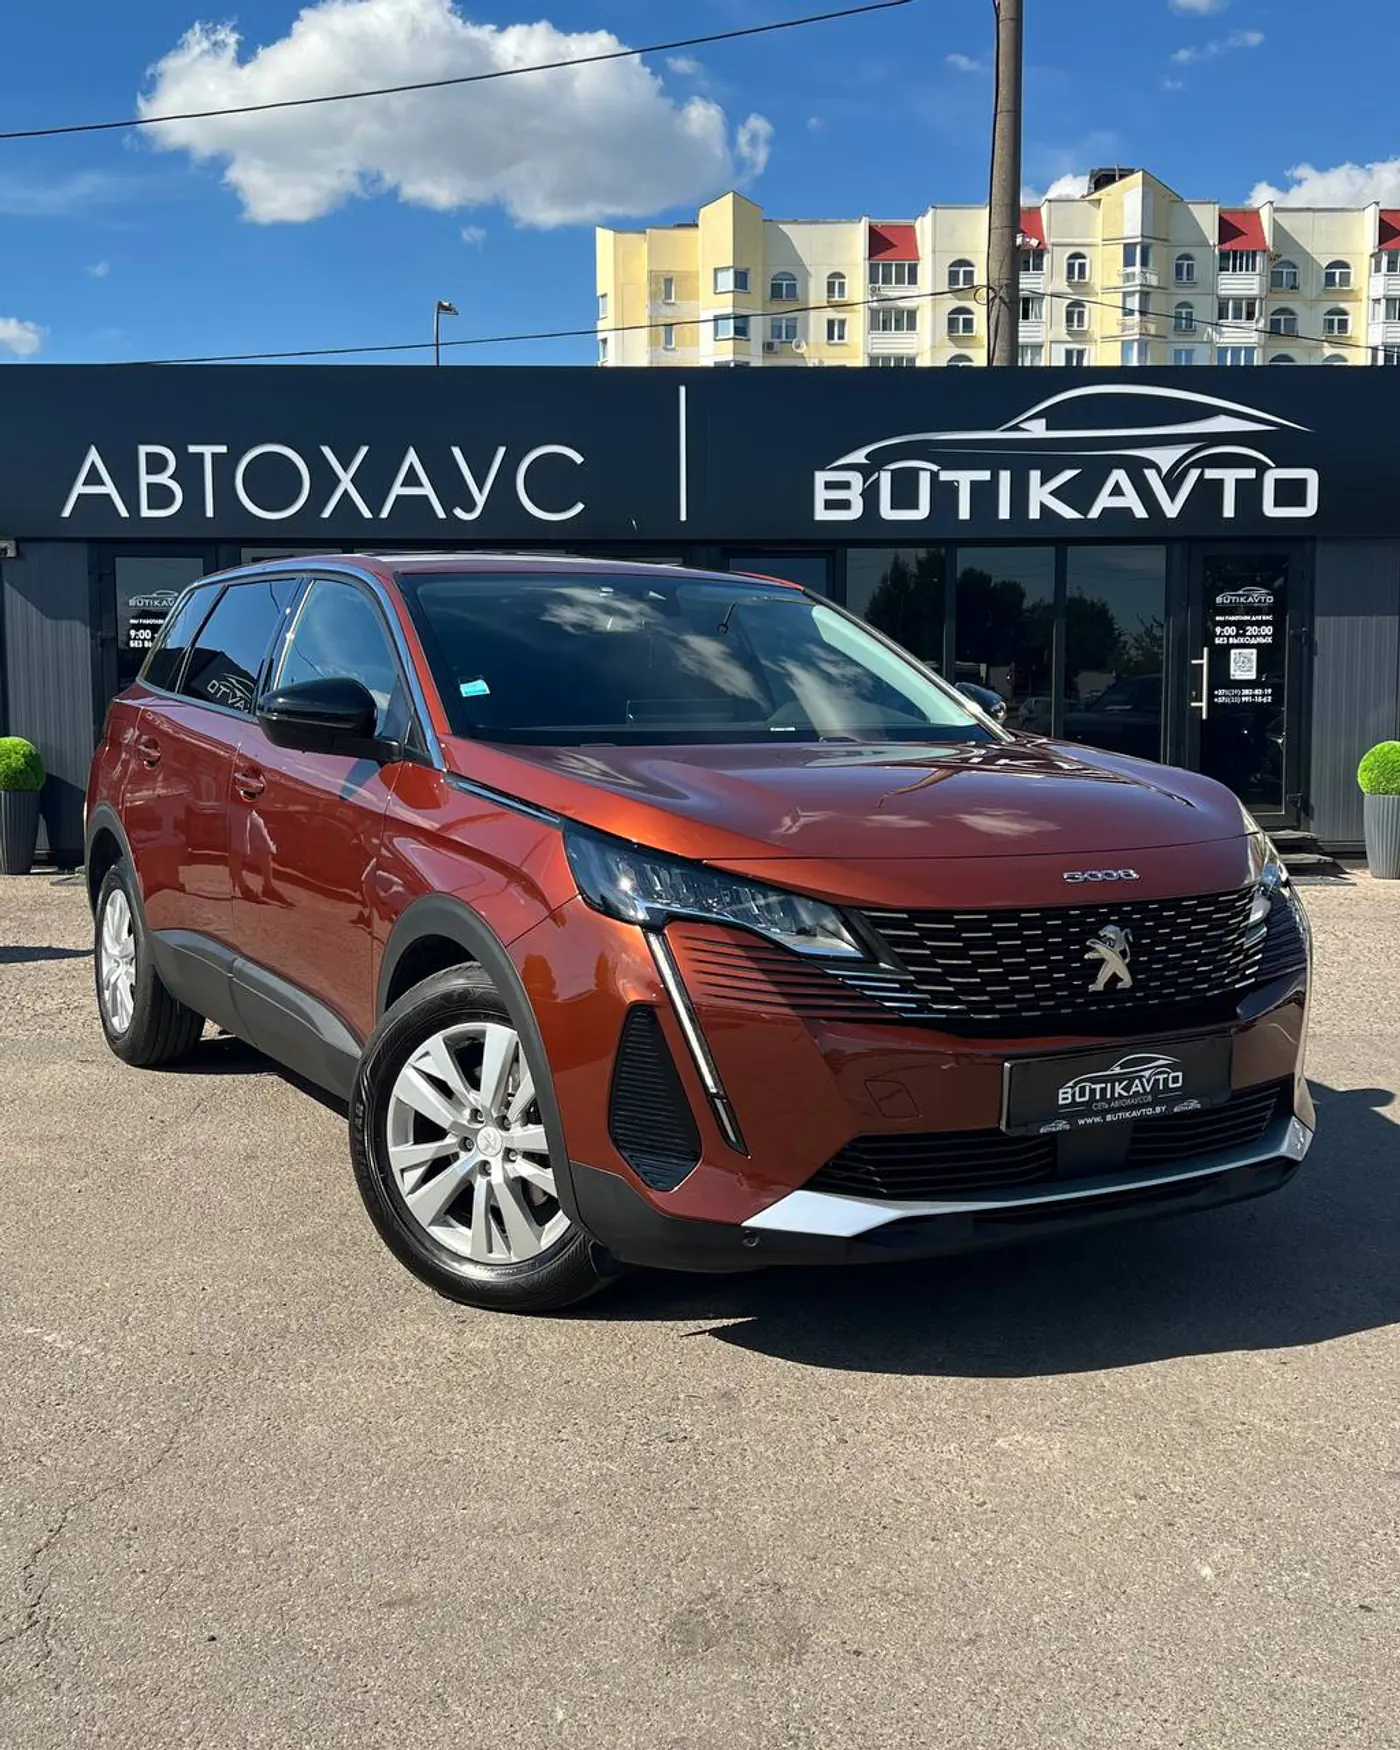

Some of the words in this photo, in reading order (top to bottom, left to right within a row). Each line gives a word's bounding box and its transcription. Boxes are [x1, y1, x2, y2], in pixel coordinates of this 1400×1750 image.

[60, 443, 586, 522] АВТОХАУС
[813, 466, 1320, 521] BUTIKAVTO
[129, 598, 175, 607] BUTIKAV
[1215, 595, 1274, 604] BUTIKAVTO
[129, 629, 152, 640] 9:00
[1215, 626, 1236, 636] 9:00
[1246, 626, 1273, 636] 20:00
[129, 640, 143, 648] БЕЗ
[1214, 636, 1228, 644] БЕЗ
[1228, 636, 1273, 645] ВЫХОДНЫХ
[1063, 869, 1140, 882] 5008
[1058, 1071, 1183, 1105] BUTIKAVTO
[1077, 1115, 1104, 1126] WWW.
